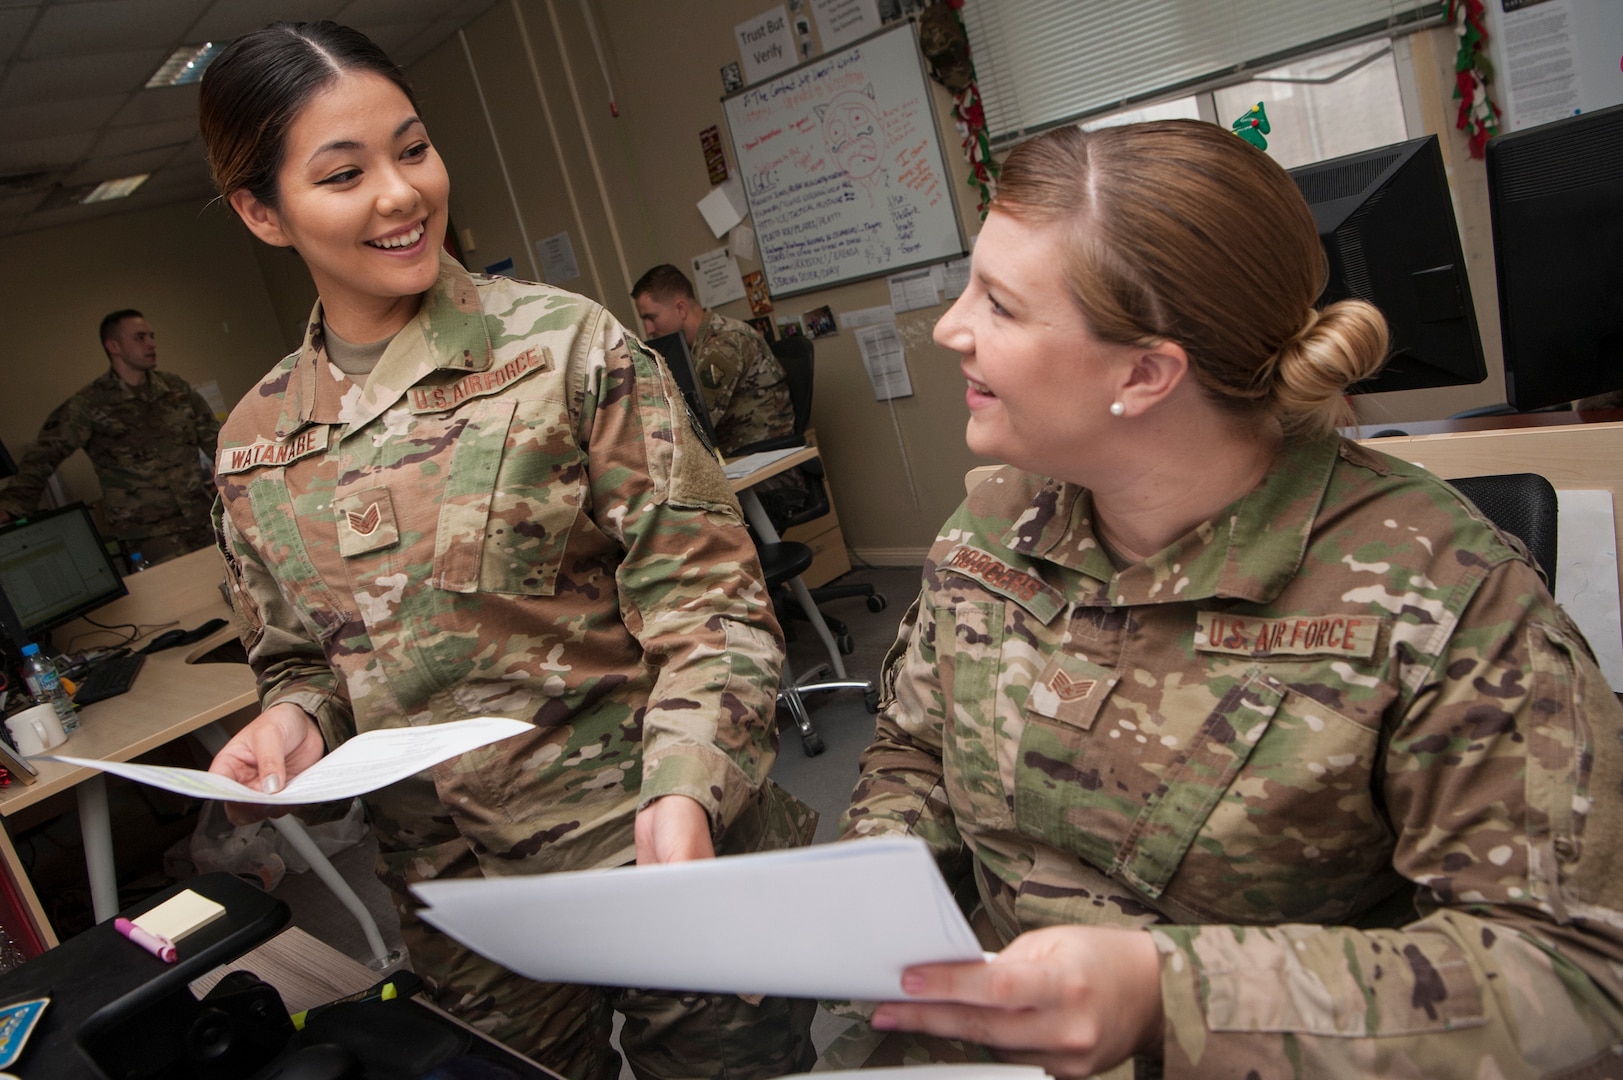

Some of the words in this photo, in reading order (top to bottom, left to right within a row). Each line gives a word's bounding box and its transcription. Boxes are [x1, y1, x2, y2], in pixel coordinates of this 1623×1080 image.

[740, 27, 767, 45] Trust
[767, 17, 786, 35] But
[753, 44, 784, 65] Verify
[412, 389, 450, 410] U.S.
[453, 375, 482, 403] AIR
[484, 349, 540, 388] FORCE
[231, 430, 317, 470] WATANABE
[949, 547, 1041, 602] RODGERS
[1208, 619, 1249, 650] U.S.
[1256, 621, 1287, 652] AIR
[1288, 619, 1362, 651] FORCE
